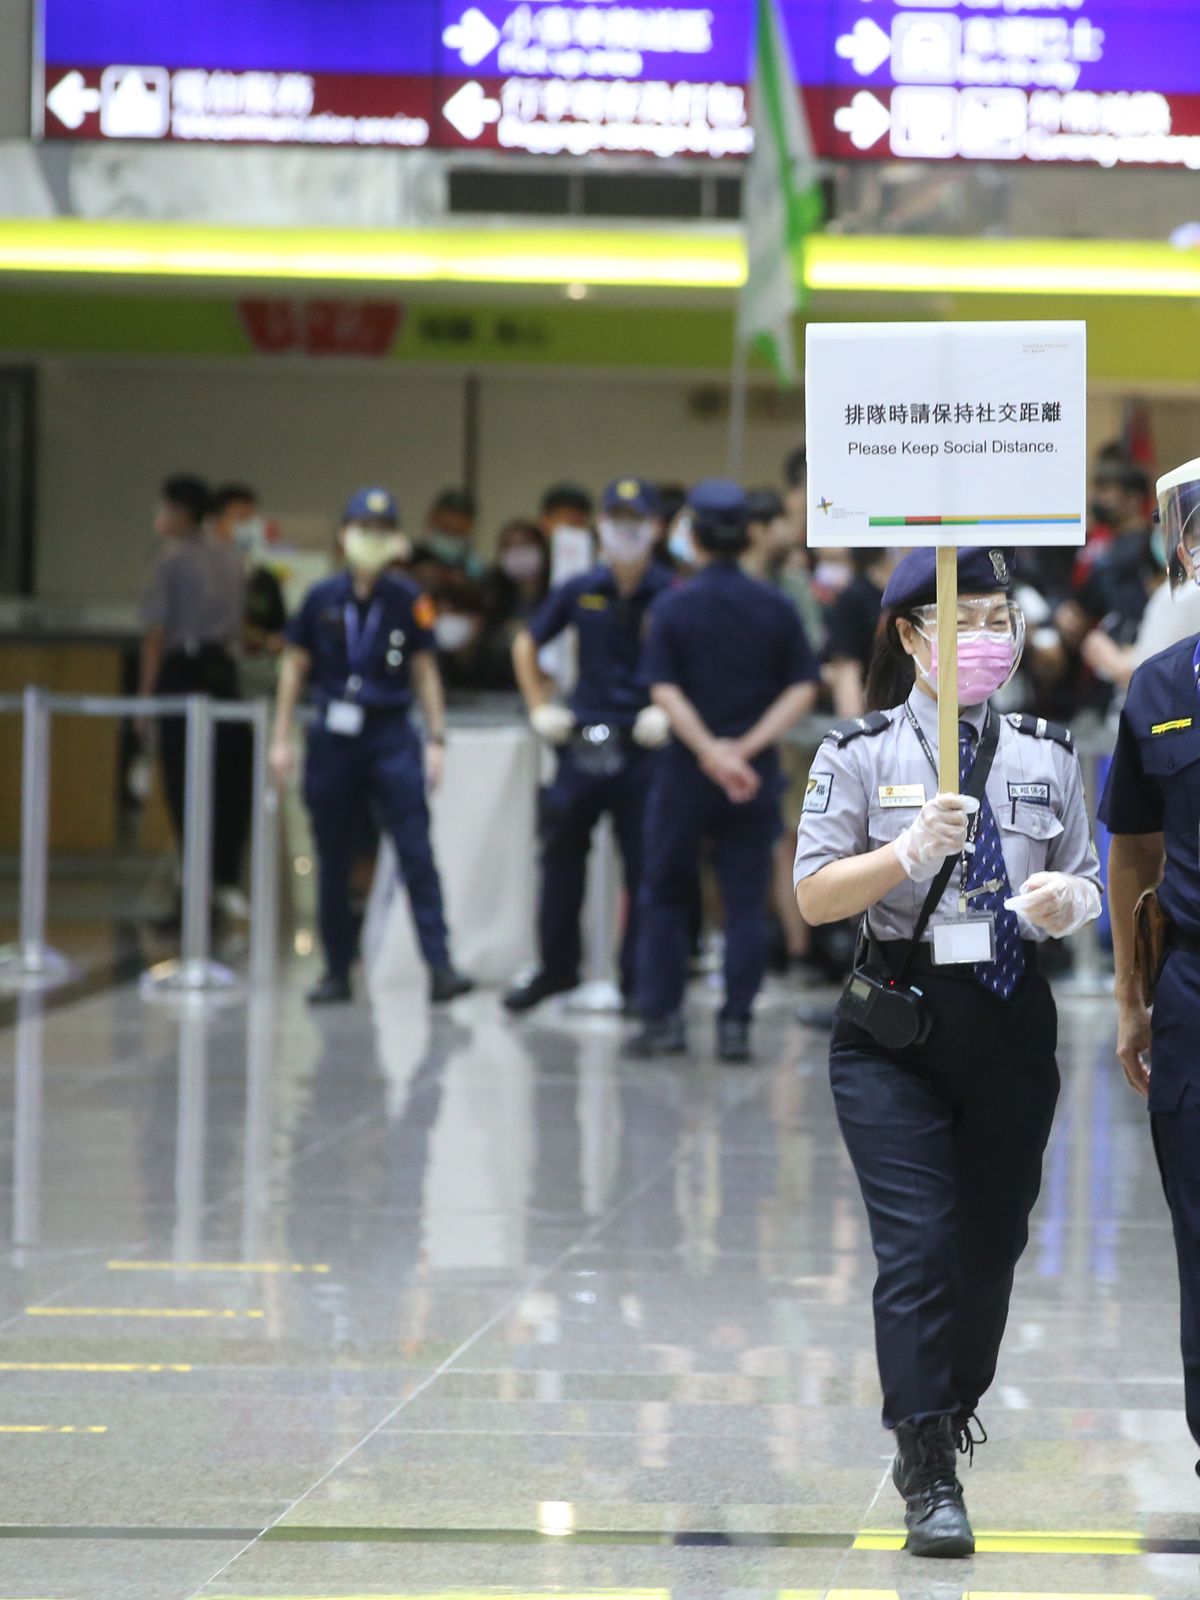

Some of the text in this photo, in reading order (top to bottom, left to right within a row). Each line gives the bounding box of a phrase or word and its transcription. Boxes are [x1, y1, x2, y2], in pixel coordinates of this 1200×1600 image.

[844, 401, 1062, 425] 排隊時請保持社交距離
[848, 439, 1058, 457] Please Keep Social Distance.
